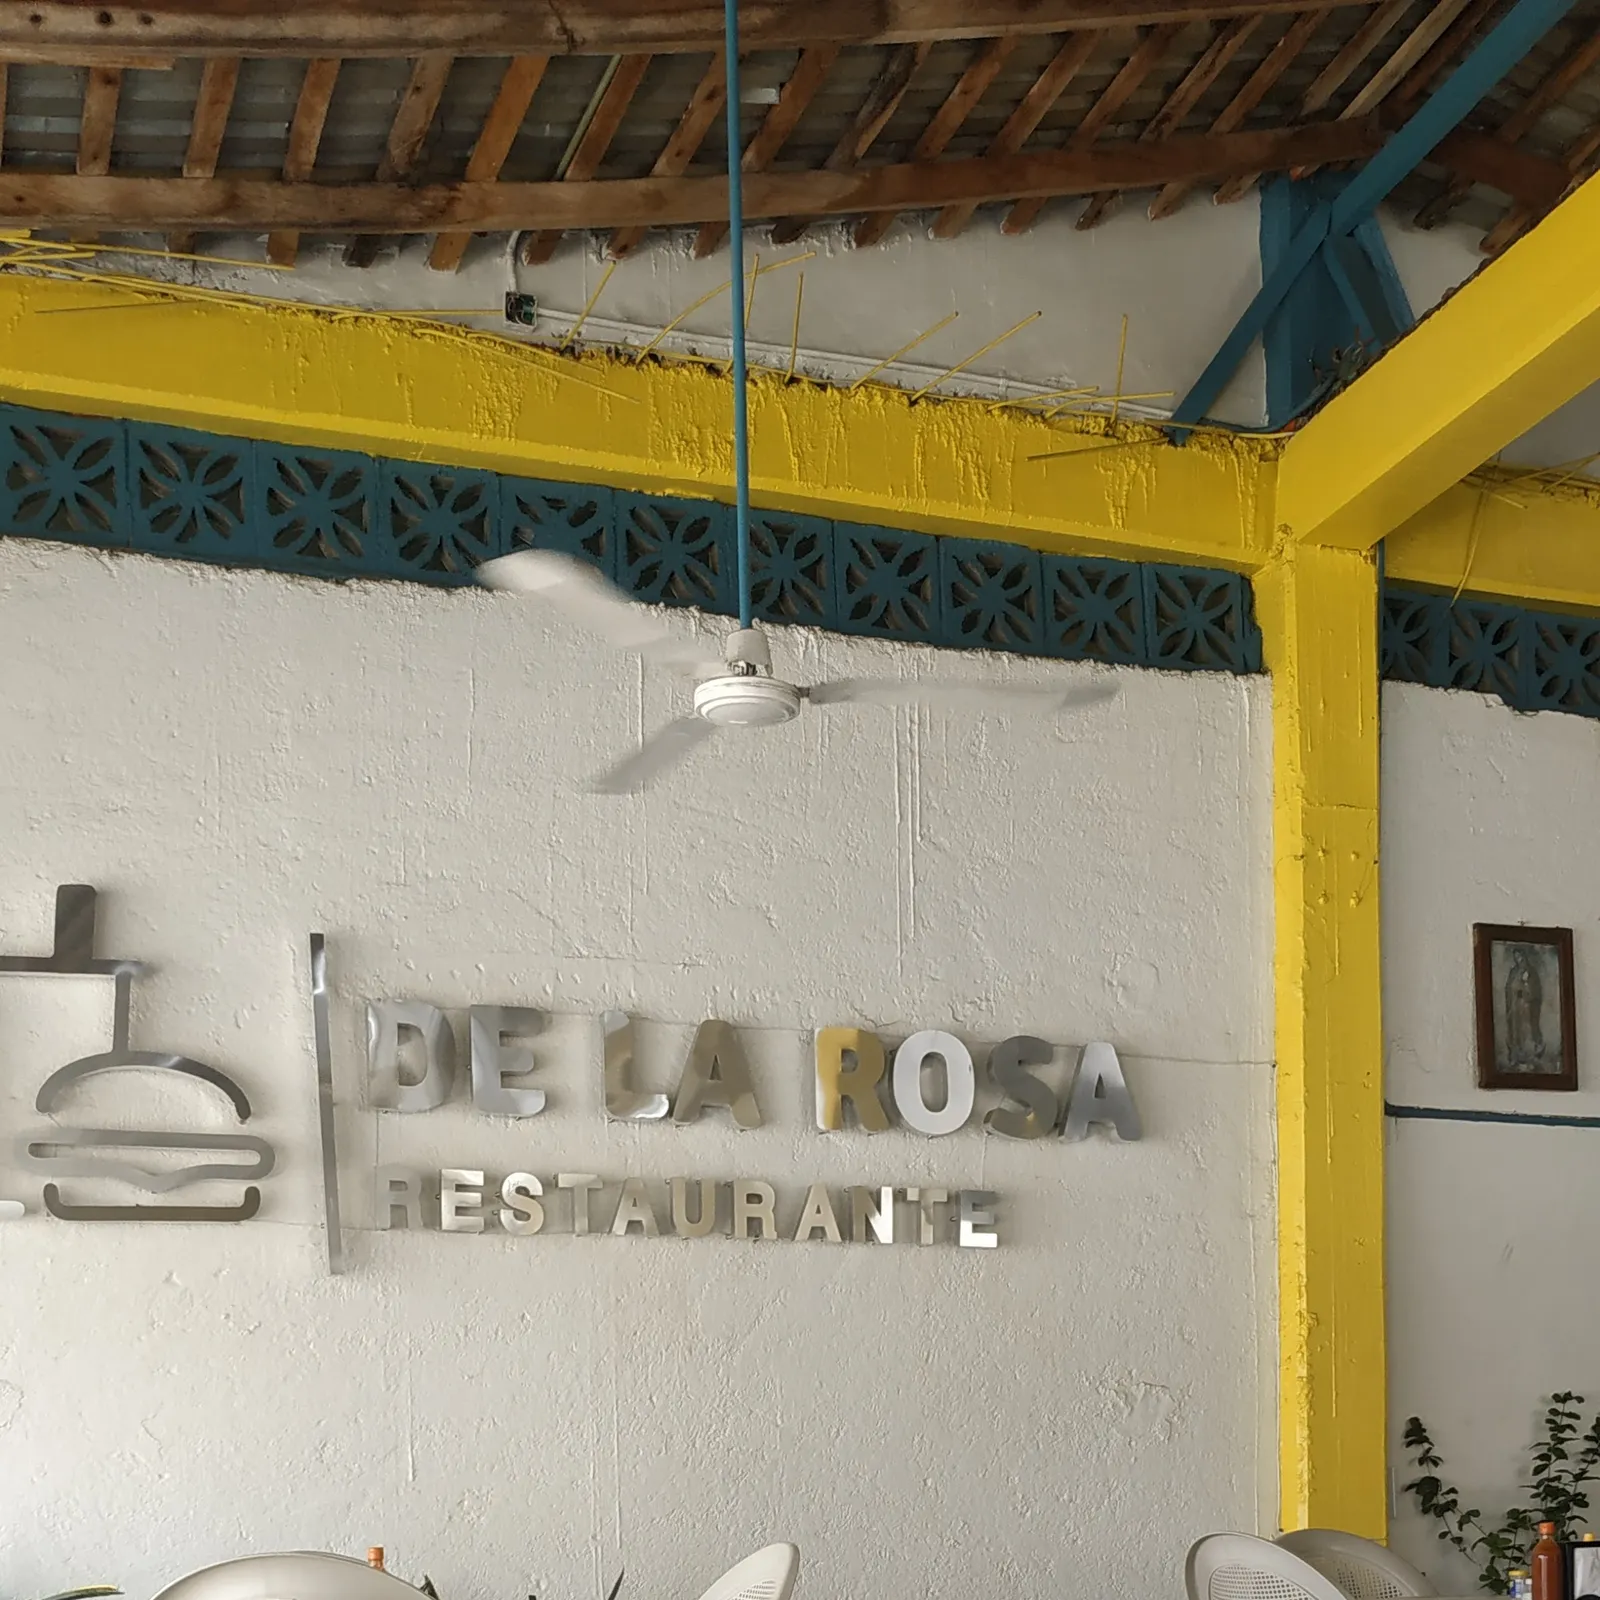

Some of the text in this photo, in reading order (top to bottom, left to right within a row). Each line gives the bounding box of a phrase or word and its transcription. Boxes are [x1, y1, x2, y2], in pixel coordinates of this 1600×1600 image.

[367, 1003, 1142, 1143] DE LA ROSA
[376, 1165, 999, 1248] RESTAURANTE
